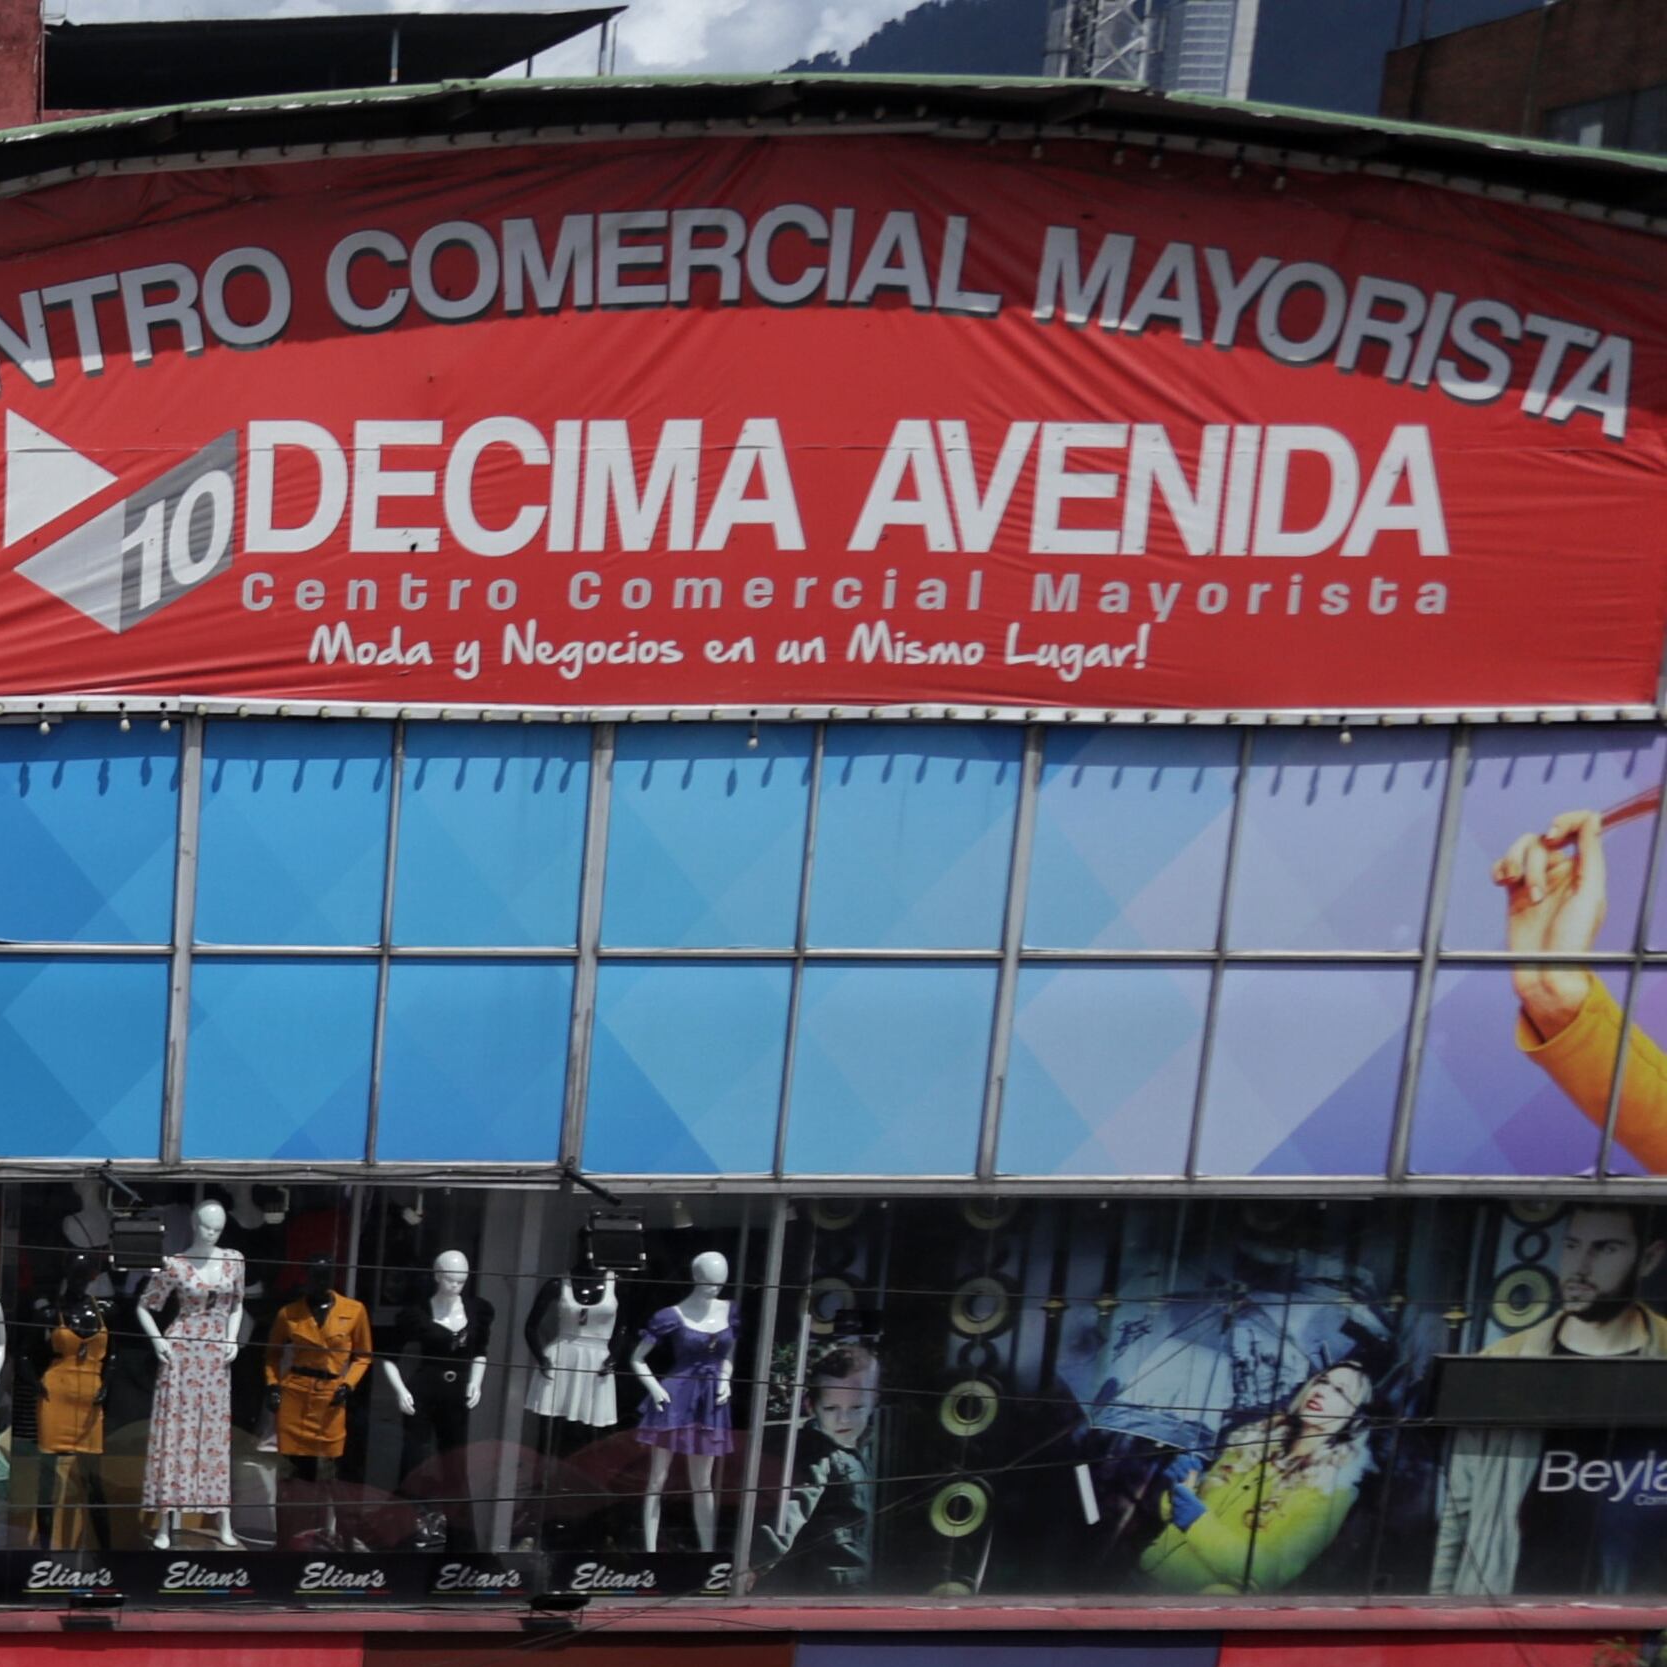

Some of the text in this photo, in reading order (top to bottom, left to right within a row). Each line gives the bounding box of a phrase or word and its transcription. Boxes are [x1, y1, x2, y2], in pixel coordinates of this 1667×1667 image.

[325, 203, 1001, 331] COMERCIAL
[1033, 225, 1634, 442] MAYORISTA
[119, 416, 1450, 611] 10 DECIMA AVENIDA
[242, 568, 1448, 622] Centro Comercial Mayorista
[309, 619, 1151, 682] Moda y Negocios en un Mismo Lugar!
[27, 1561, 114, 1587] Elian's
[164, 1561, 251, 1587] Elian's
[301, 1561, 387, 1587] Elian's
[437, 1561, 526, 1587] Elian's
[572, 1561, 658, 1587] Elian's
